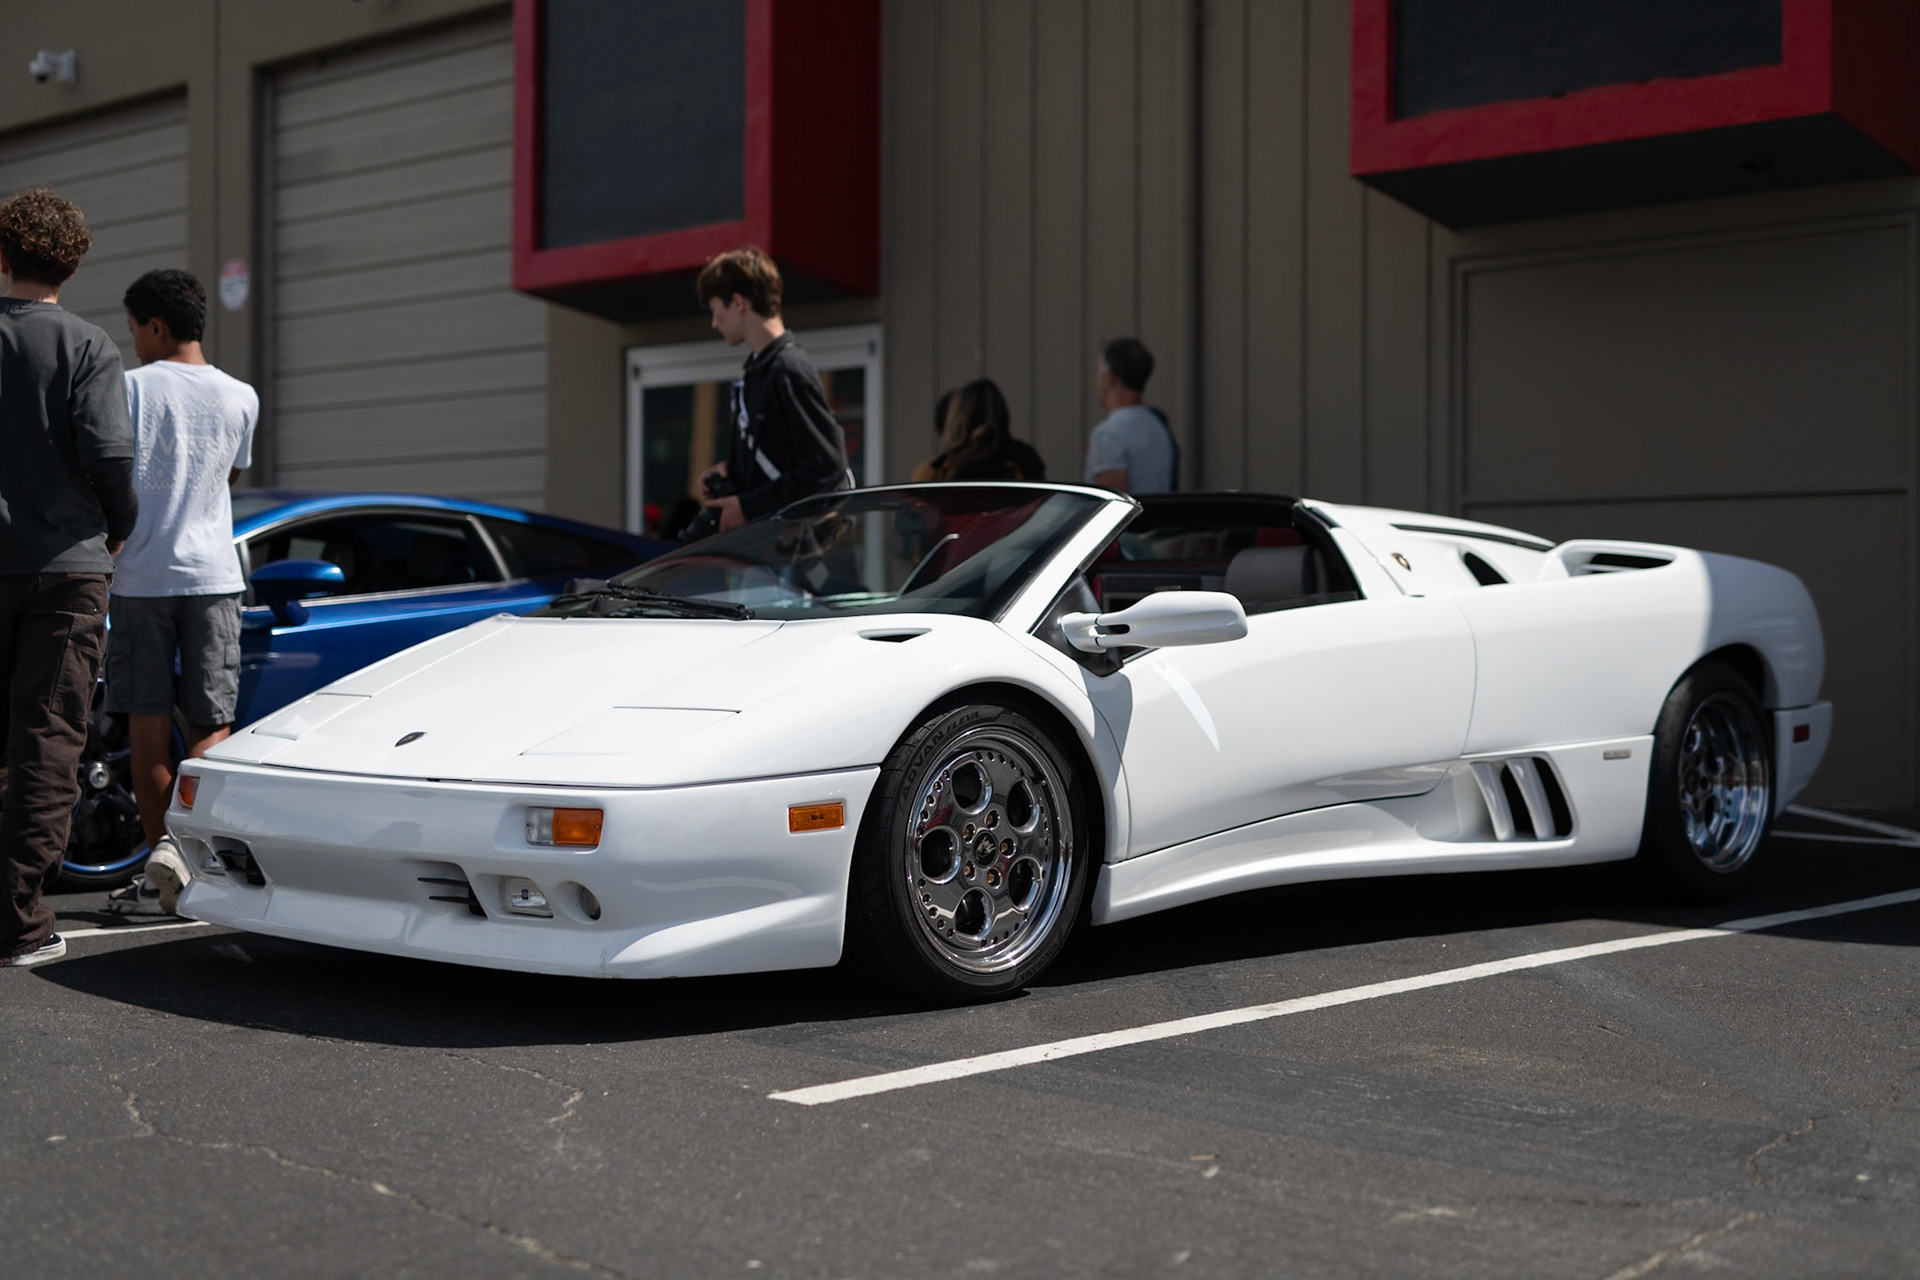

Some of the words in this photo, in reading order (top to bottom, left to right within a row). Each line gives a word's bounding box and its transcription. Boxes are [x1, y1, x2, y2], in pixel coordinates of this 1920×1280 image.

[902, 731, 945, 801] ADVAN
[946, 711, 979, 734] FLEVA
[1019, 942, 1058, 981] YOKOHAMA
